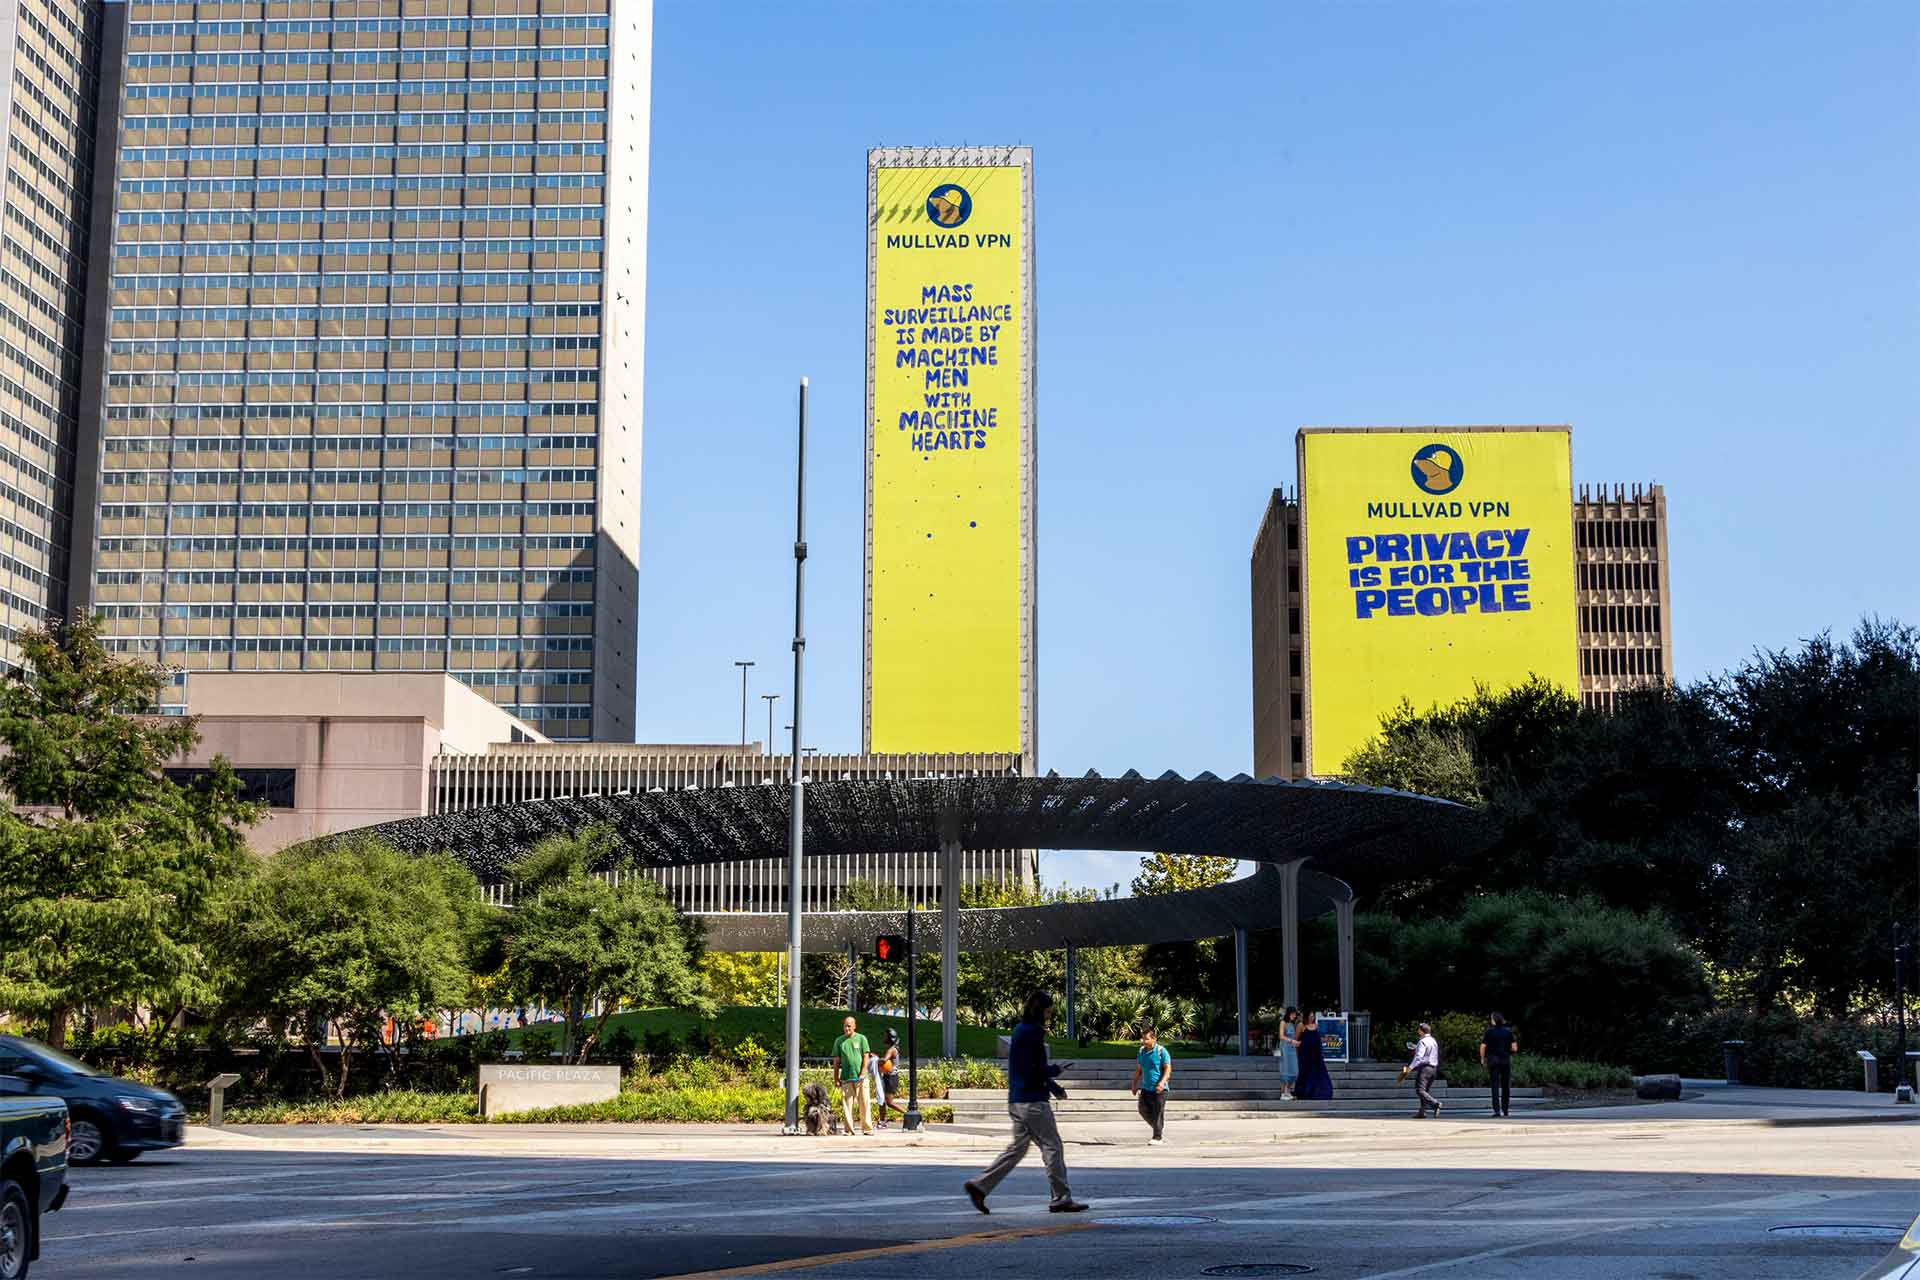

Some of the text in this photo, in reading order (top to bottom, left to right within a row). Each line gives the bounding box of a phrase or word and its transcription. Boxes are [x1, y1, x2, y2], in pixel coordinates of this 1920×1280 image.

[887, 234, 1010, 248] MULLVAD VPN
[922, 284, 972, 304] MASS
[884, 305, 1011, 325] SURVEILLANCE
[896, 325, 1000, 344] IS MADE BY
[896, 346, 997, 368] MACHINE
[926, 369, 968, 389] MEN
[924, 392, 970, 408] WITH
[899, 408, 997, 431] MACHINE
[912, 430, 986, 451] HEARTS
[1368, 502, 1509, 518] MULLVAD VPN
[1346, 529, 1530, 564] PRIVACY
[1349, 559, 1530, 587] IS FOR THE
[1356, 584, 1530, 619] PEOPLE
[498, 1070, 601, 1081] PACIFIC PLAZA
